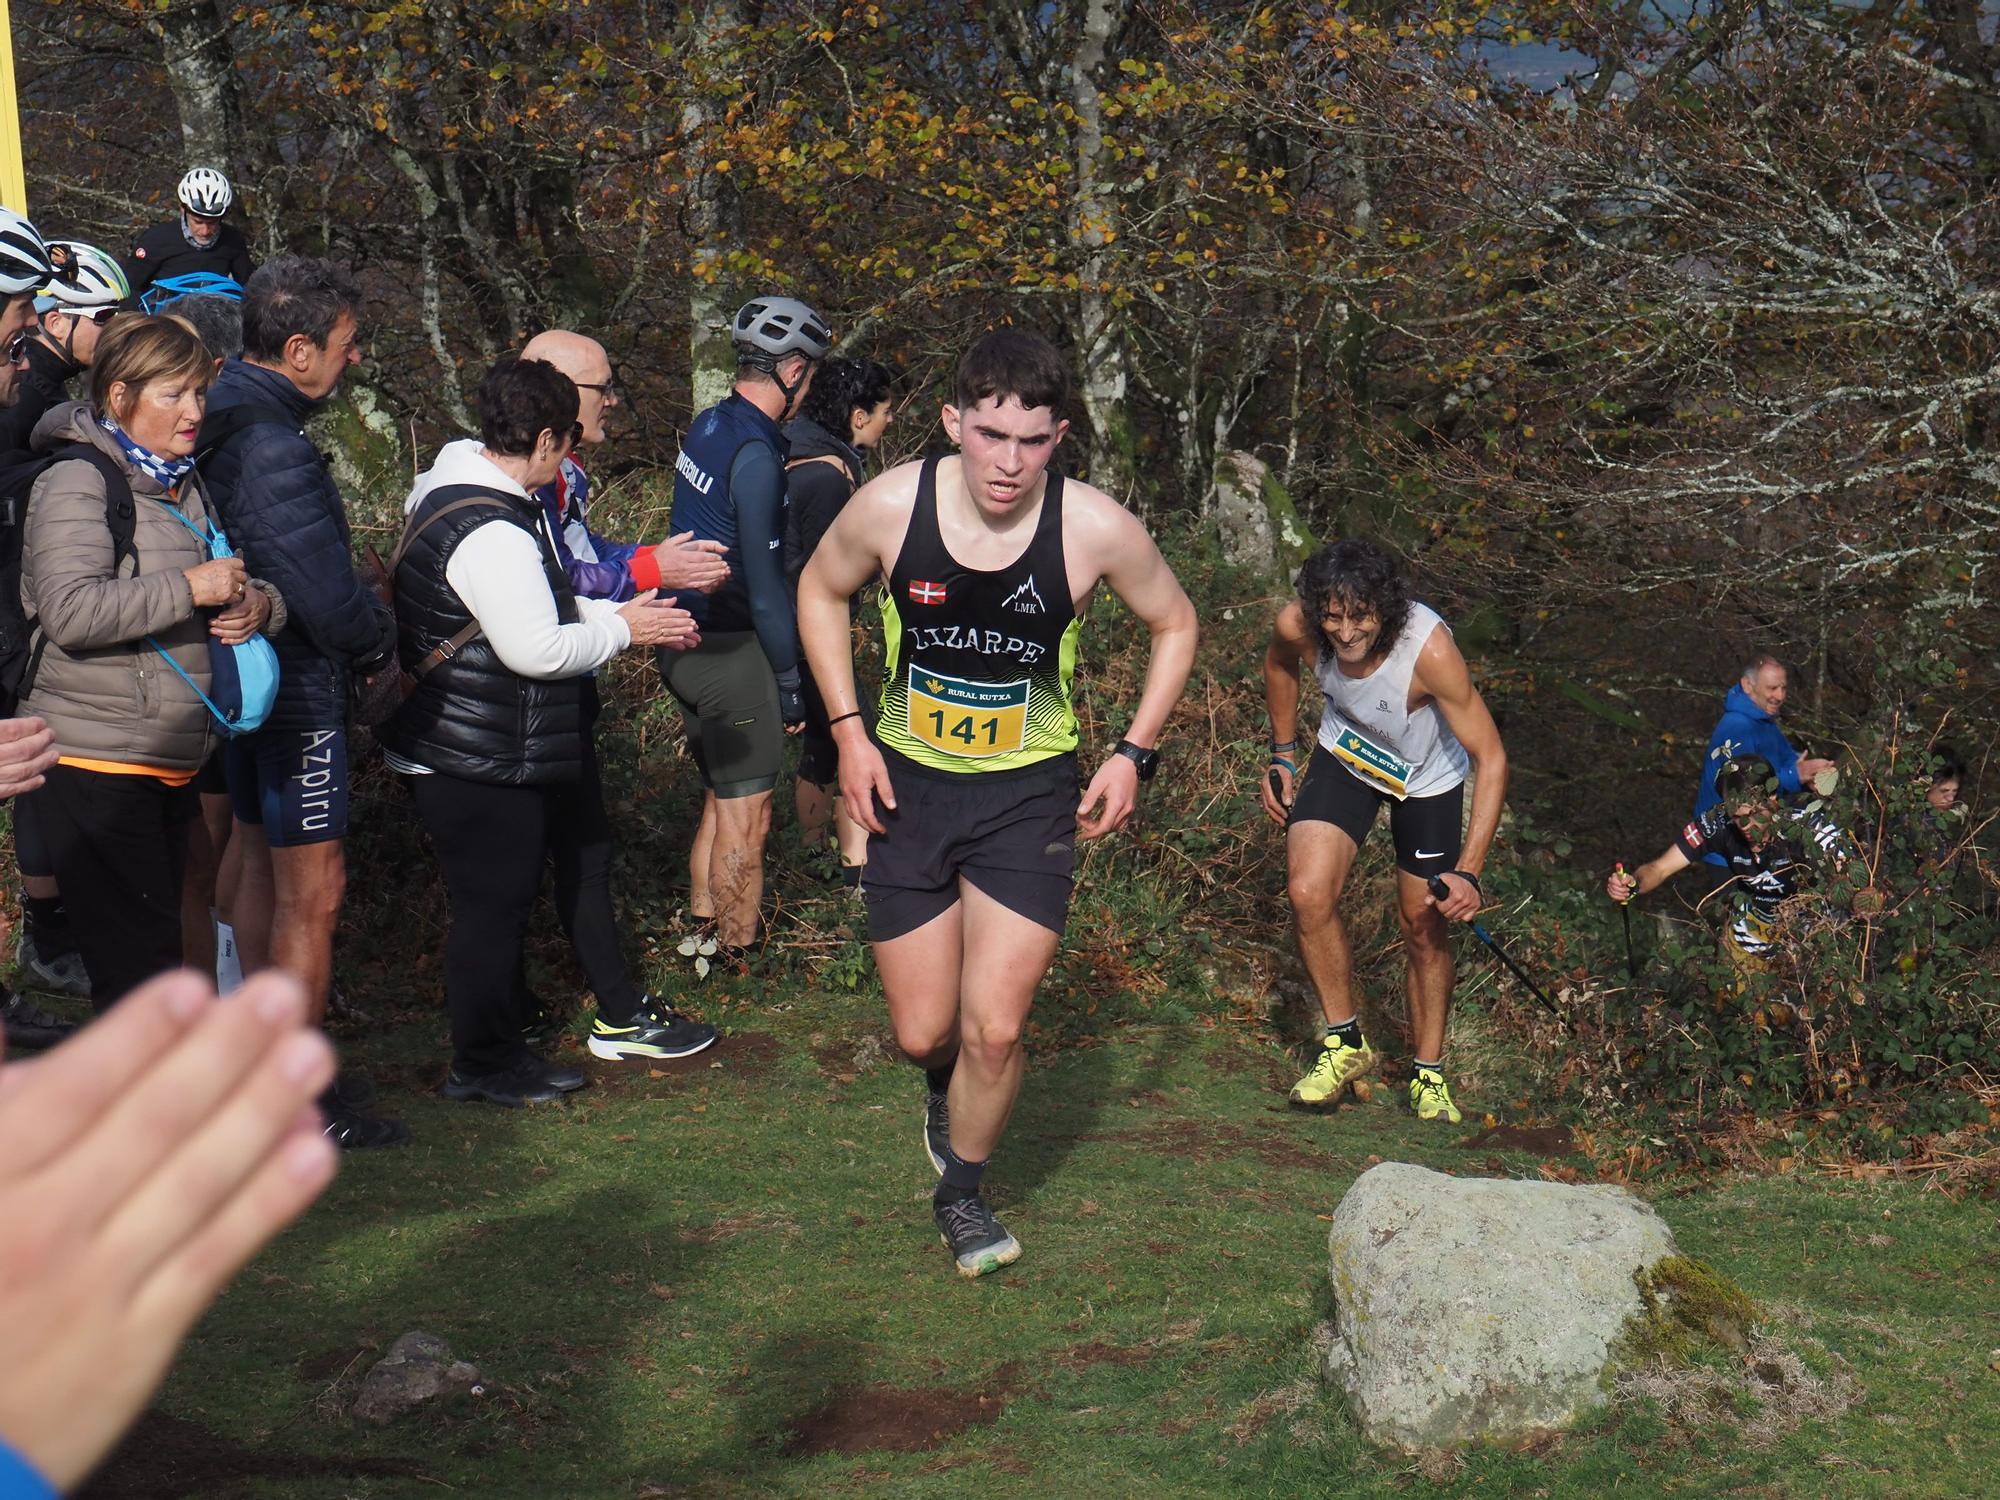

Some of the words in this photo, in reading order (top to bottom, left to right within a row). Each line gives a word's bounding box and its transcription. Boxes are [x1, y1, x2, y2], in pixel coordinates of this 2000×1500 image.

[1014, 602, 1037, 614] LMK
[907, 626, 1046, 663] LIZARPE
[947, 688, 977, 700] RURAL
[979, 693, 1012, 701] KUTXA
[928, 709, 998, 745] 141
[1360, 747, 1379, 761] RURAL
[291, 730, 338, 831] Azpiru
